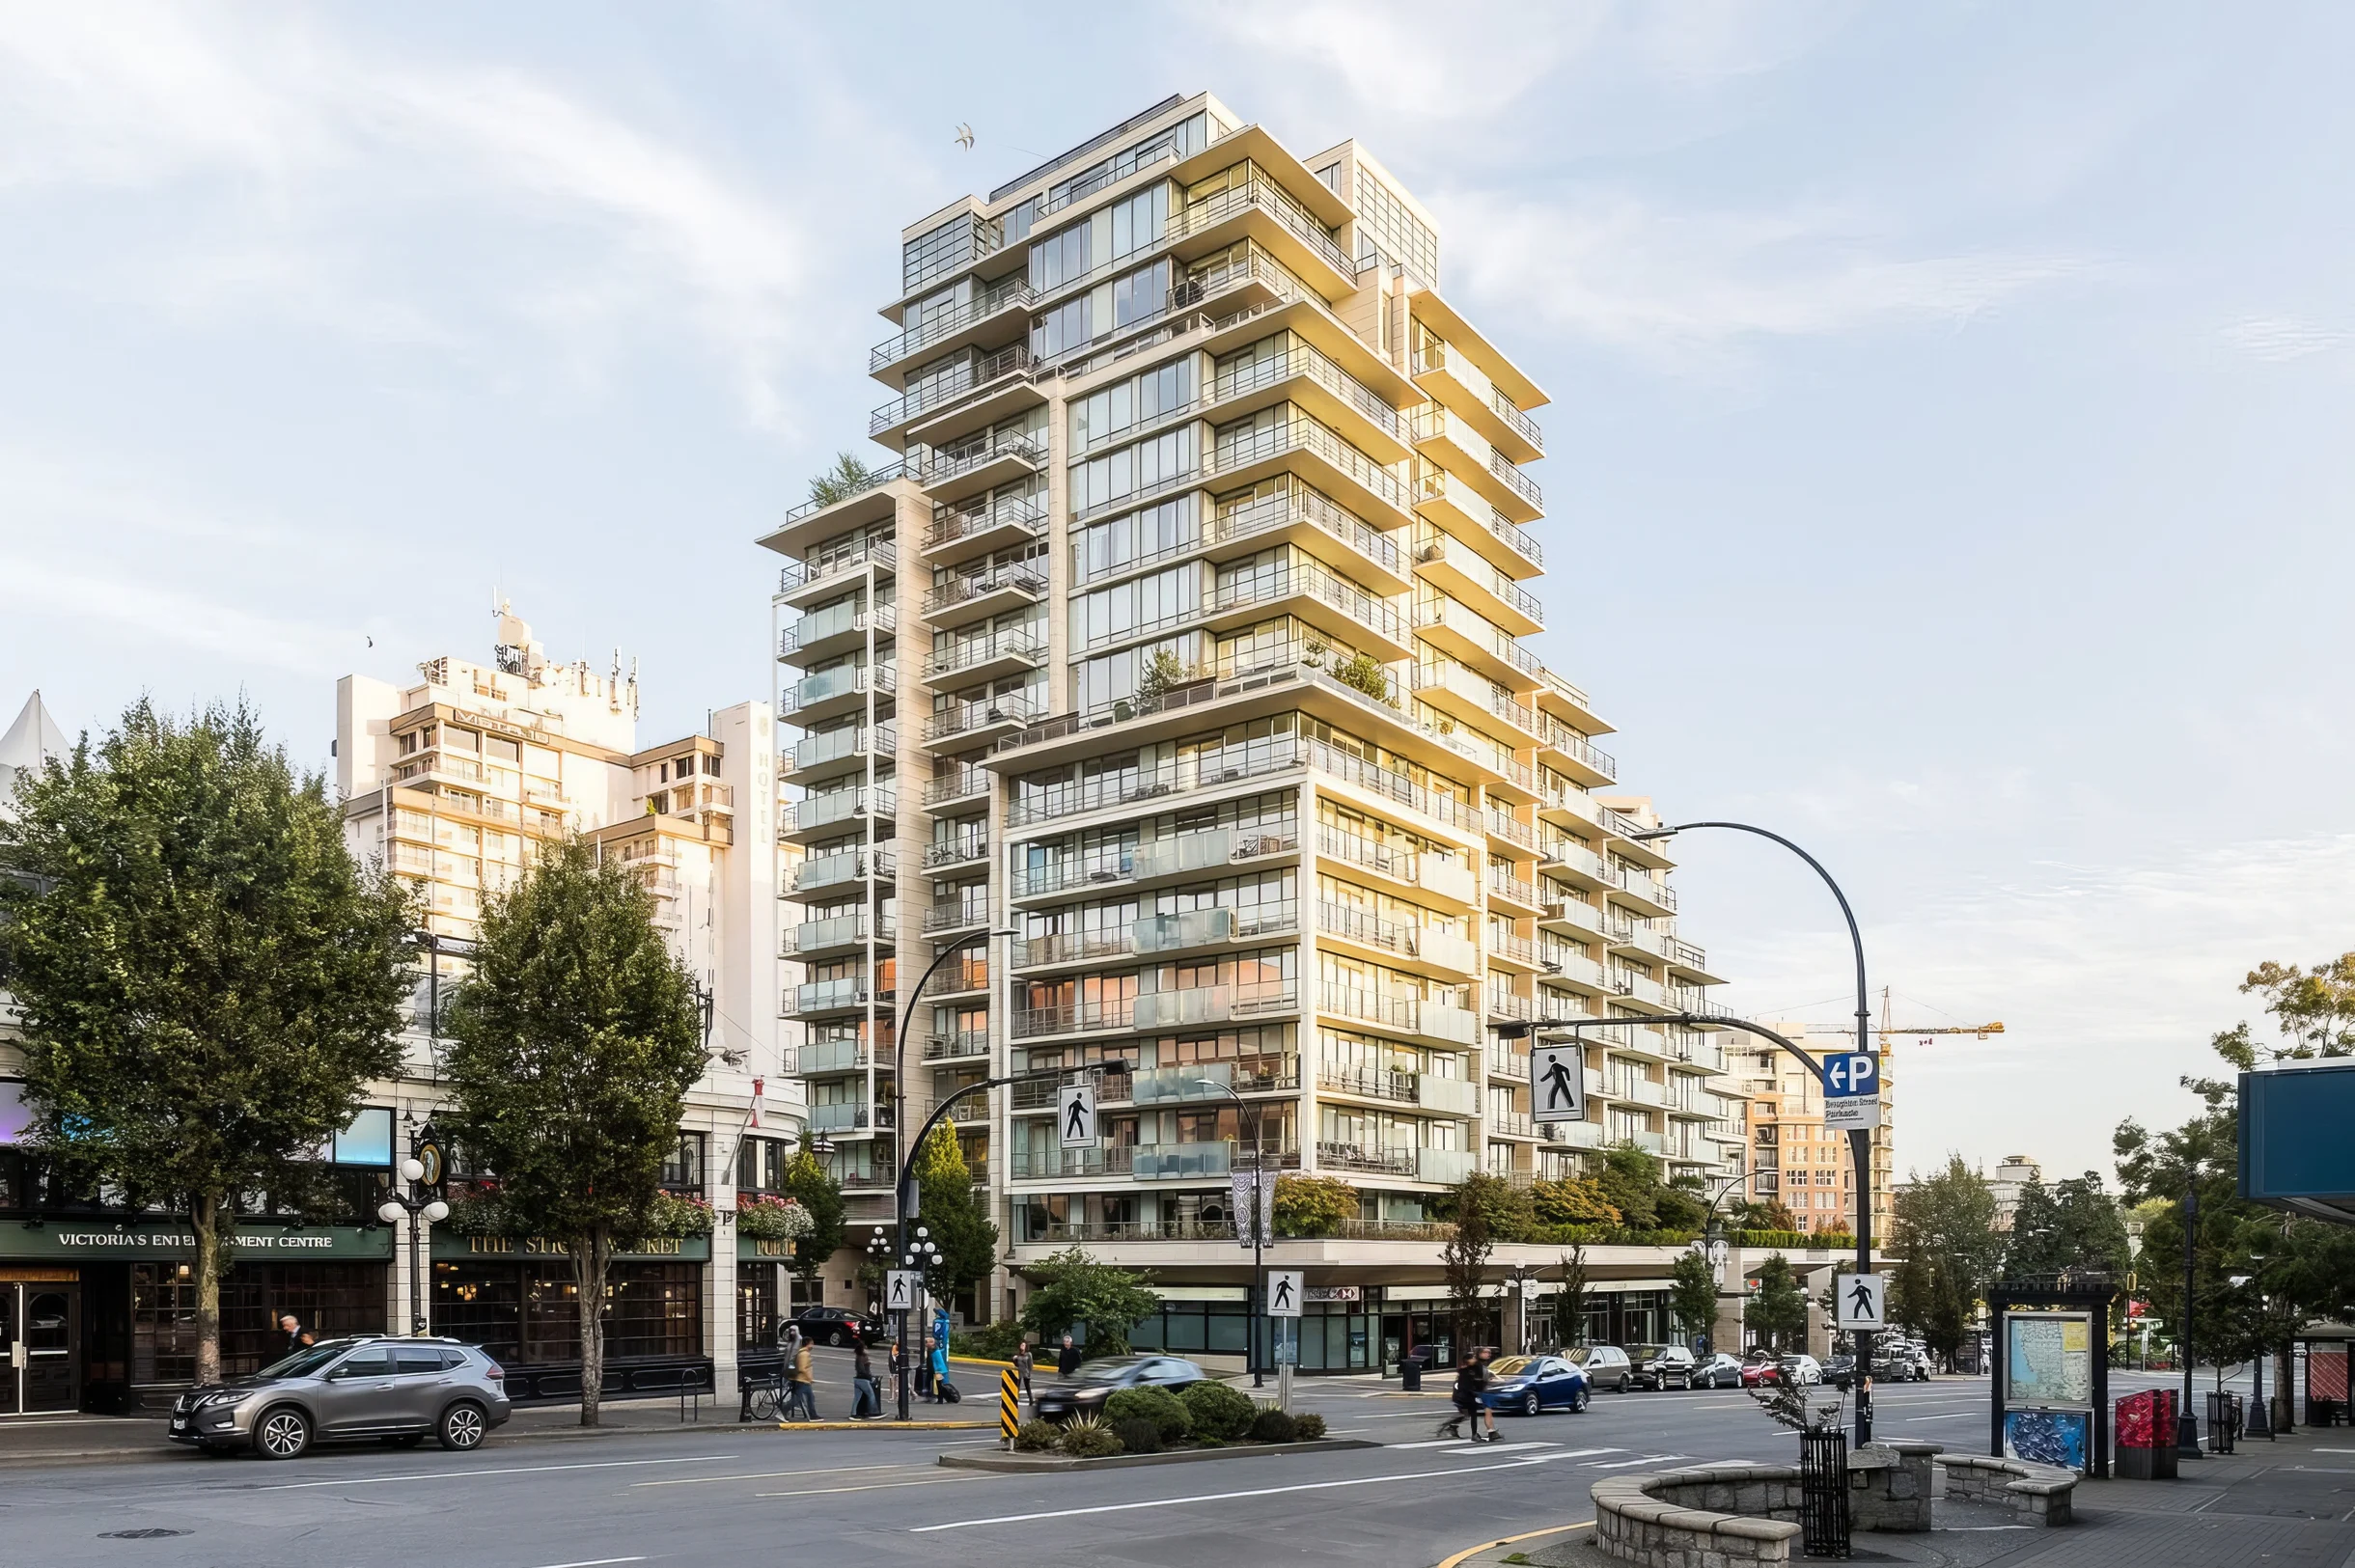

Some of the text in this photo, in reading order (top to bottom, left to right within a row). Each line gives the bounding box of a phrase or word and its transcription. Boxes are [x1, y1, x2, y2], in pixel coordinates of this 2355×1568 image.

[1849, 1057, 1873, 1091] P
[59, 1234, 147, 1246] VICTORIA'S
[278, 1236, 333, 1248] CENTRE
